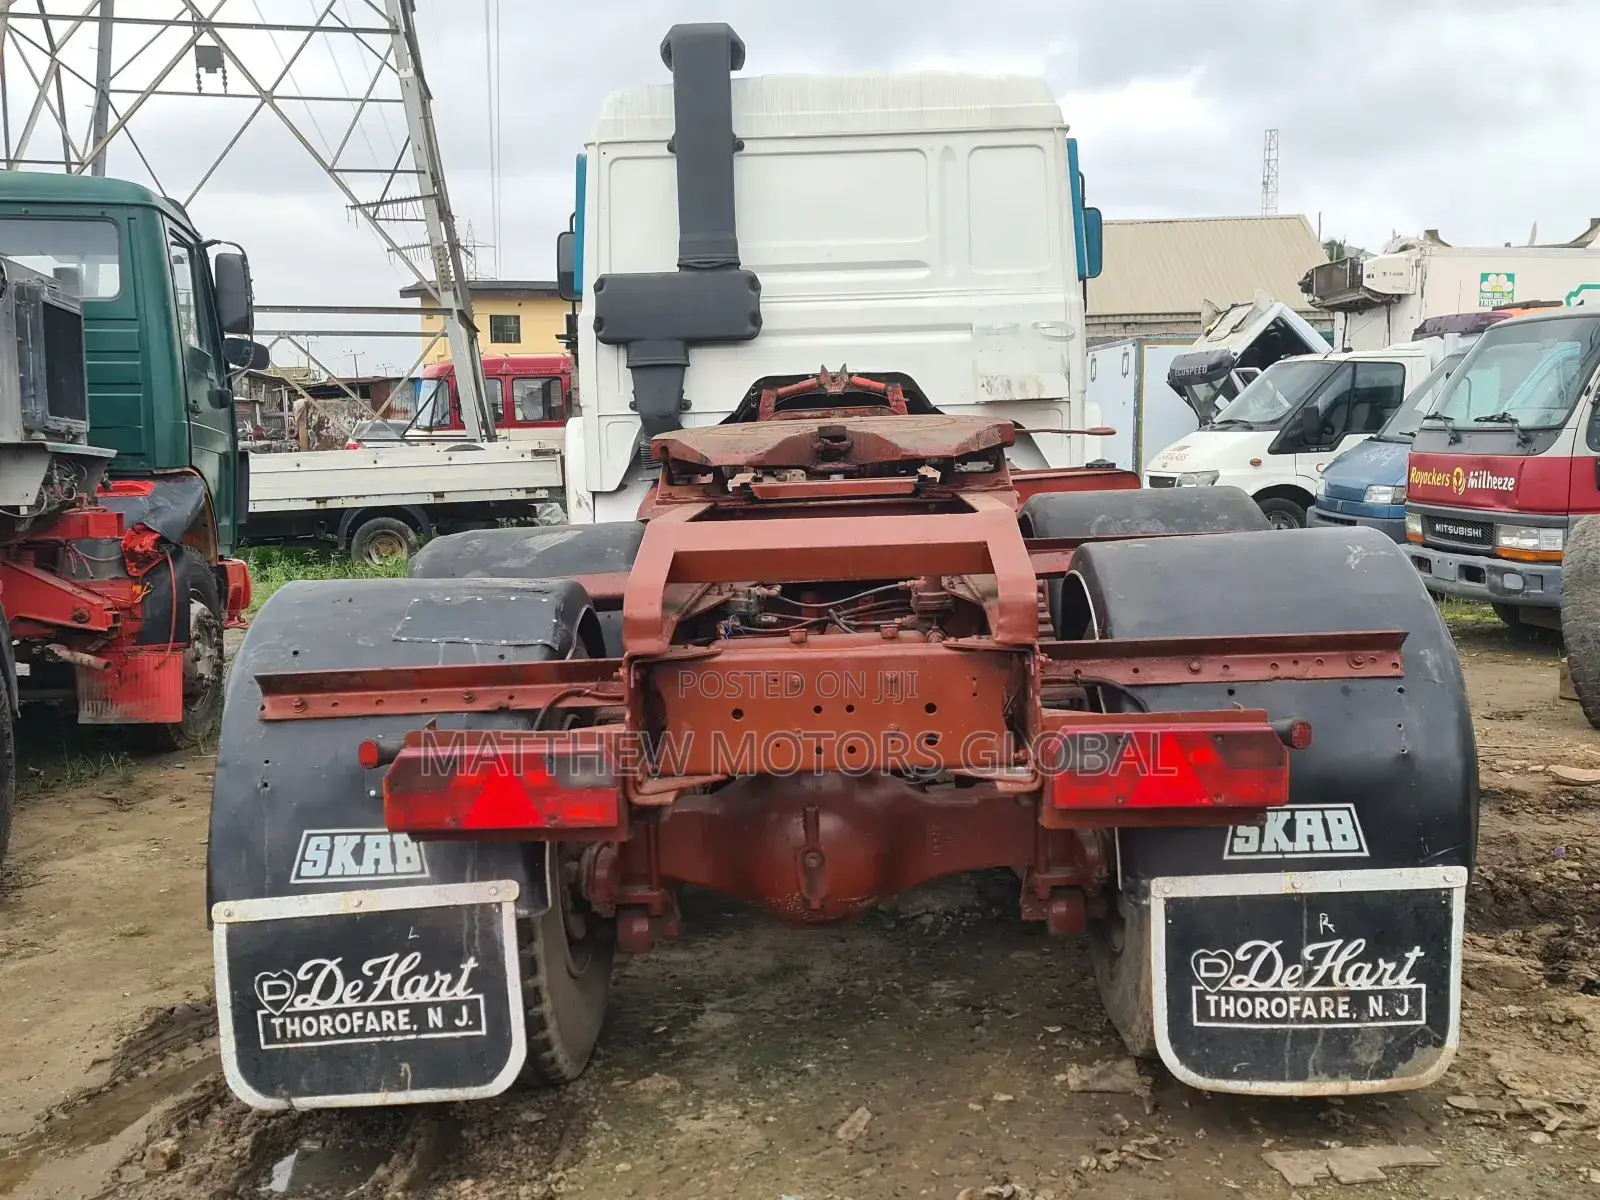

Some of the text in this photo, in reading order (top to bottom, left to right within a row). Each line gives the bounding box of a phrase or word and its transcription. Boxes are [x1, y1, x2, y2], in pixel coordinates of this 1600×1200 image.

[1175, 364, 1208, 377] ECOSPEED
[1467, 470, 1515, 492] Milheeze
[1435, 523, 1482, 538] MITSUBISHI
[1233, 810, 1359, 852] SKAB
[300, 833, 422, 877] SKAB
[1229, 938, 1426, 989] DeHart
[294, 951, 479, 1008] DeHart
[1205, 995, 1358, 1020] THOROFARE,
[271, 1008, 418, 1039] THOROFARE,
